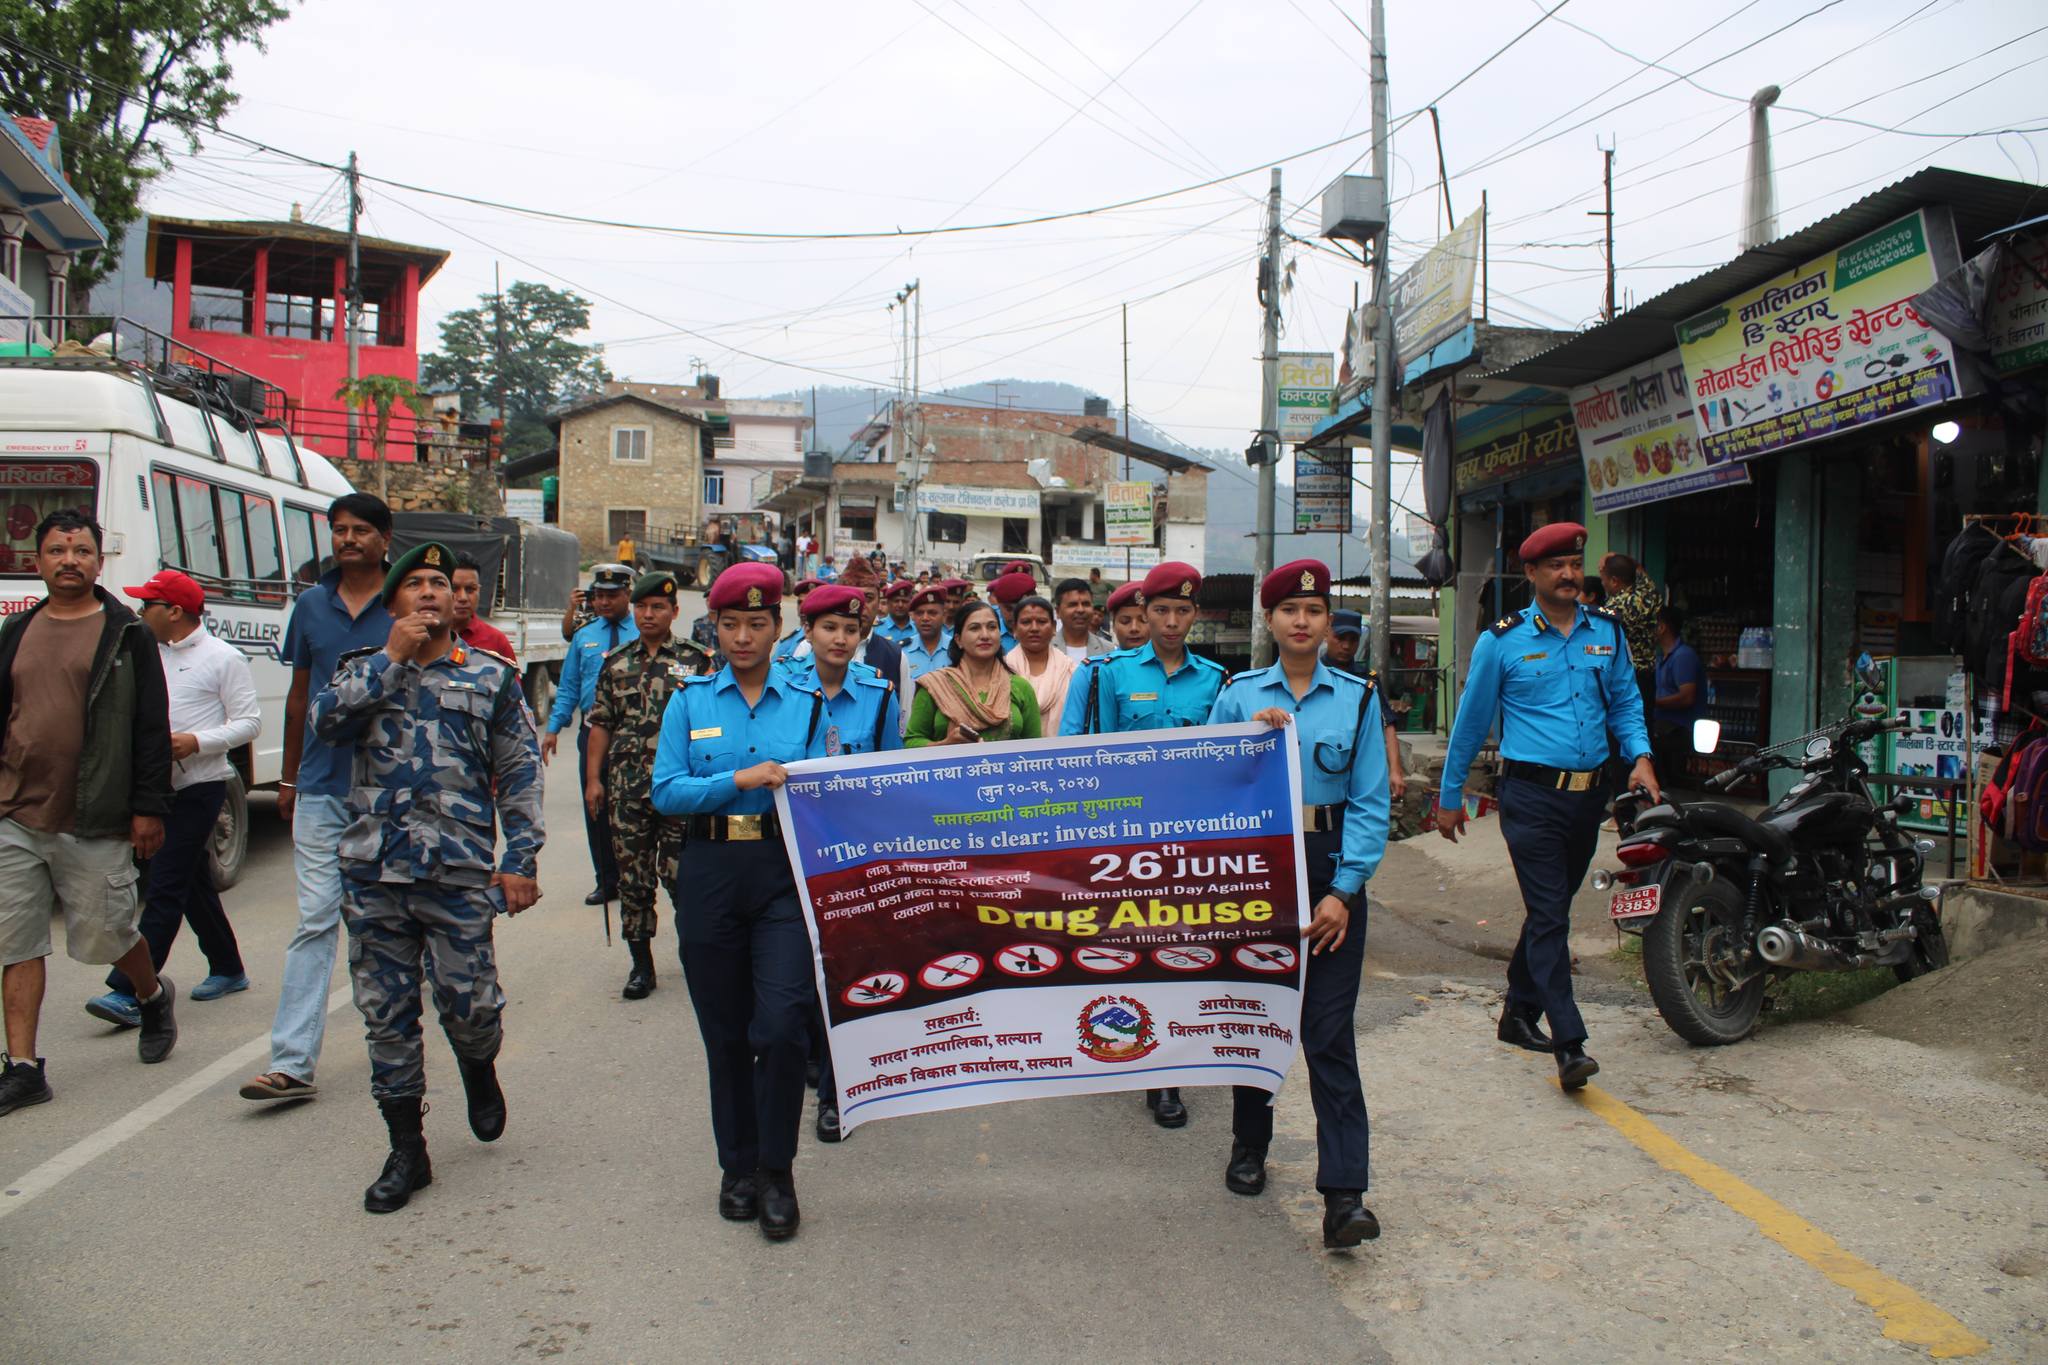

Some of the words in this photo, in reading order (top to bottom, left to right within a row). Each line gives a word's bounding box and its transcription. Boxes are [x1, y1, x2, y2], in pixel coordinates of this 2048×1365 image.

[1738, 270, 1827, 322] मालिका
[1694, 350, 1768, 397] मोबाईल
[788, 781, 821, 798] लागु
[824, 774, 868, 793] औषध
[870, 766, 930, 796] दुरुपयोग
[932, 766, 962, 782] तथा
[966, 758, 1004, 777] अवैध
[1009, 754, 1054, 773] ओसार
[1057, 754, 1093, 770] पसार
[1095, 745, 1158, 768] विरुद्धको
[1240, 736, 1278, 757] दिवस
[976, 785, 1003, 803] (जुन
[1007, 779, 1054, 796] २०-२६,
[1058, 776, 1100, 791] २०२४)
[932, 804, 1015, 826] सप्ताहव्यापी
[1018, 799, 1078, 821] कार्यक्रम
[1081, 796, 1144, 819] शुभारम्भ
[816, 839, 868, 864] "The
[873, 835, 962, 855] evidence
[968, 832, 985, 849] is
[990, 829, 1048, 848] clear:
[1055, 821, 1118, 843] invest
[1122, 819, 1143, 837] in
[1149, 809, 1274, 838] prevention"
[865, 865, 891, 879] लागु
[933, 859, 968, 873] प्रयोग
[1172, 854, 1270, 879] JUNE
[815, 896, 824, 907] र
[828, 888, 865, 904] ओसार
[869, 876, 912, 894] पसारमा
[878, 895, 901, 910] कडा
[904, 888, 935, 901] भन्दा
[1062, 886, 1169, 901] International
[1174, 884, 1203, 898] Day
[1207, 880, 1271, 897] Against
[892, 901, 934, 921] व्यवस्था
[976, 904, 1100, 936] Drug
[1109, 899, 1274, 929] Abuse
[1101, 935, 1131, 944] and
[1136, 932, 1178, 943] Illicit
[1199, 994, 1266, 1012] आयोजक:
[924, 1007, 981, 1031] सहकार्य:
[1168, 1021, 1215, 1038] जिल्ला
[1217, 1022, 1255, 1039] सुरक्षा
[1257, 1022, 1294, 1047] समिती
[869, 1049, 908, 1067] शारदा
[911, 1034, 994, 1057] नगरपालिका,
[996, 1032, 1042, 1047] सल्यान
[1212, 1045, 1260, 1059] सल्यान
[845, 1072, 908, 1099] सामाजिक
[910, 1063, 957, 1082] विकास
[959, 1056, 1024, 1074] कार्यालय,
[1026, 1056, 1073, 1070] सल्यान
